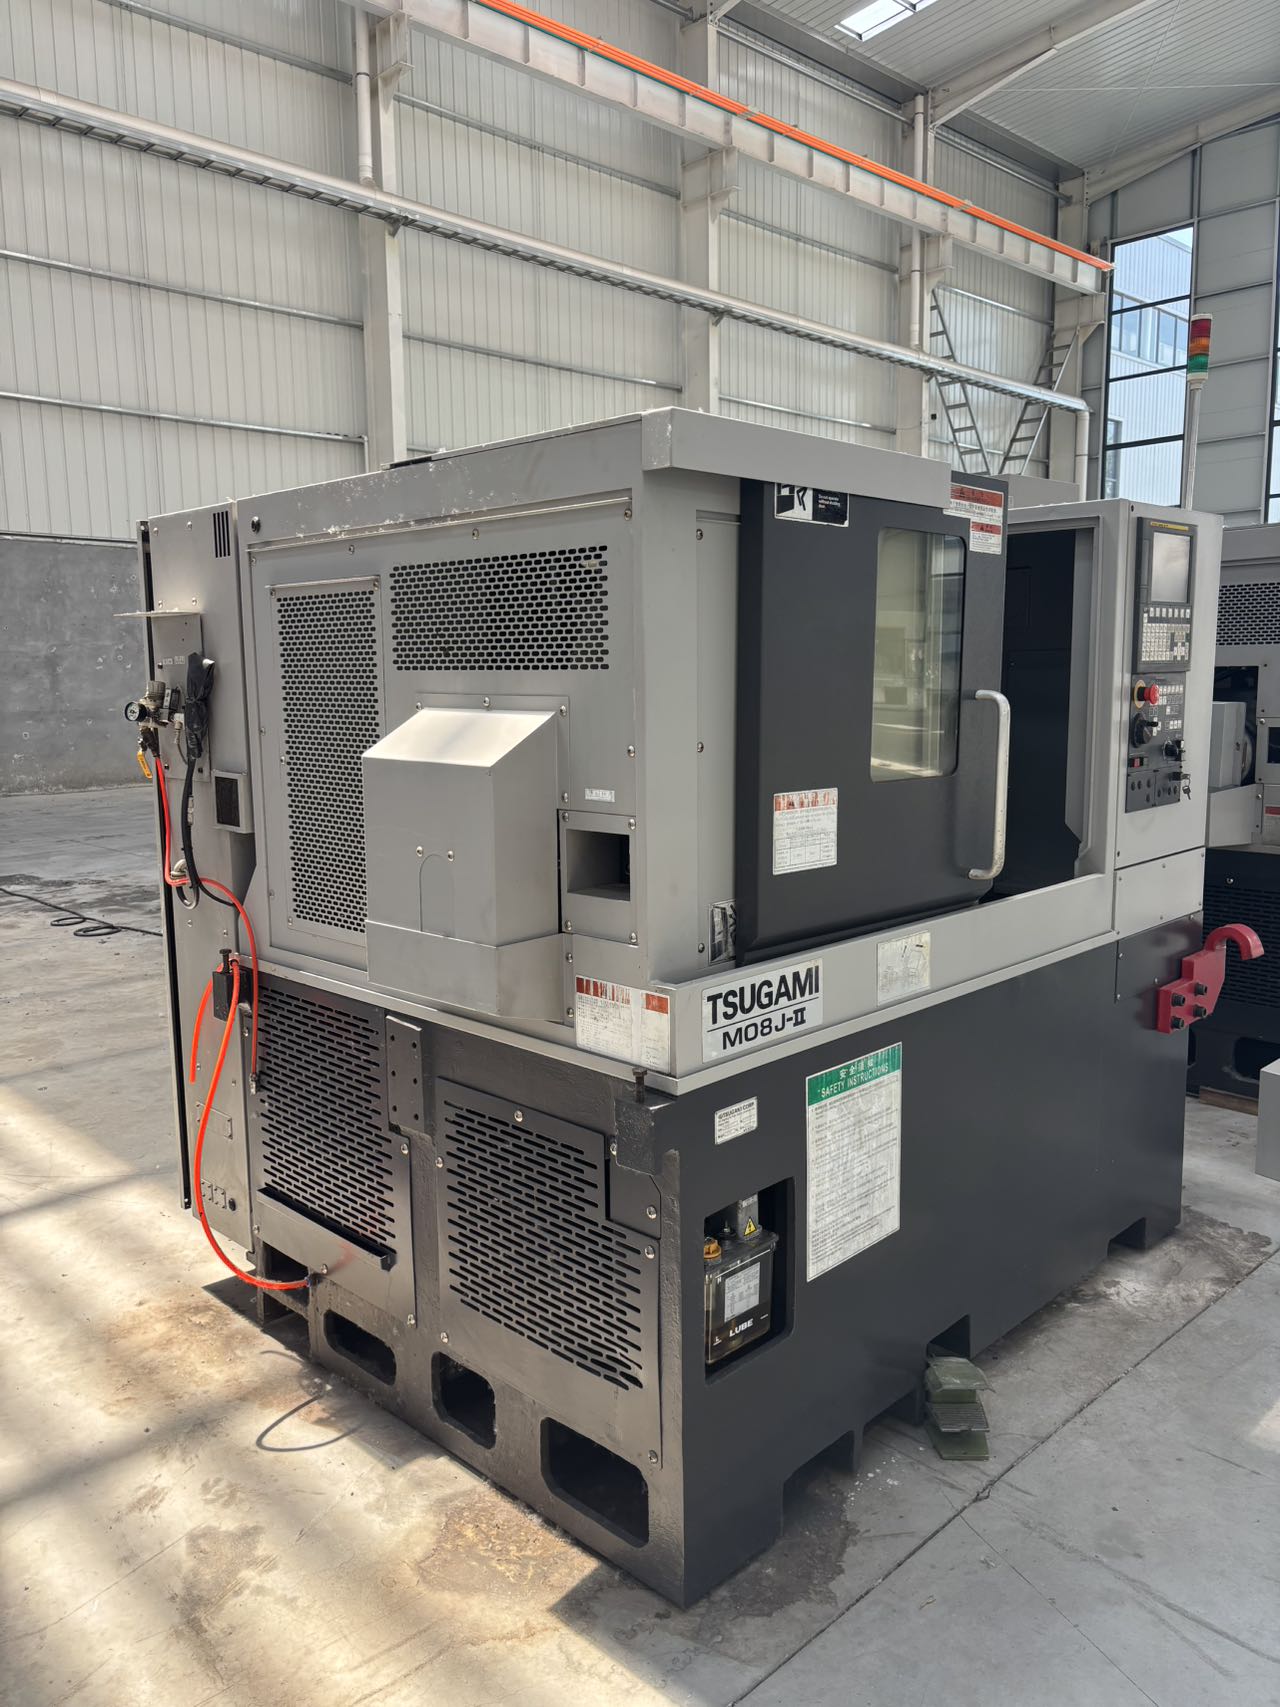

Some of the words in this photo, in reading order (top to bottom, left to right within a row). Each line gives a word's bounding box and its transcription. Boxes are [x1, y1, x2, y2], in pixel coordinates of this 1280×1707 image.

[707, 965, 819, 1025] TSUGAMI
[821, 1081, 845, 1098] SAFETY
[847, 1062, 889, 1088] INSTRUCTIONS
[729, 1318, 754, 1337] LUBE
